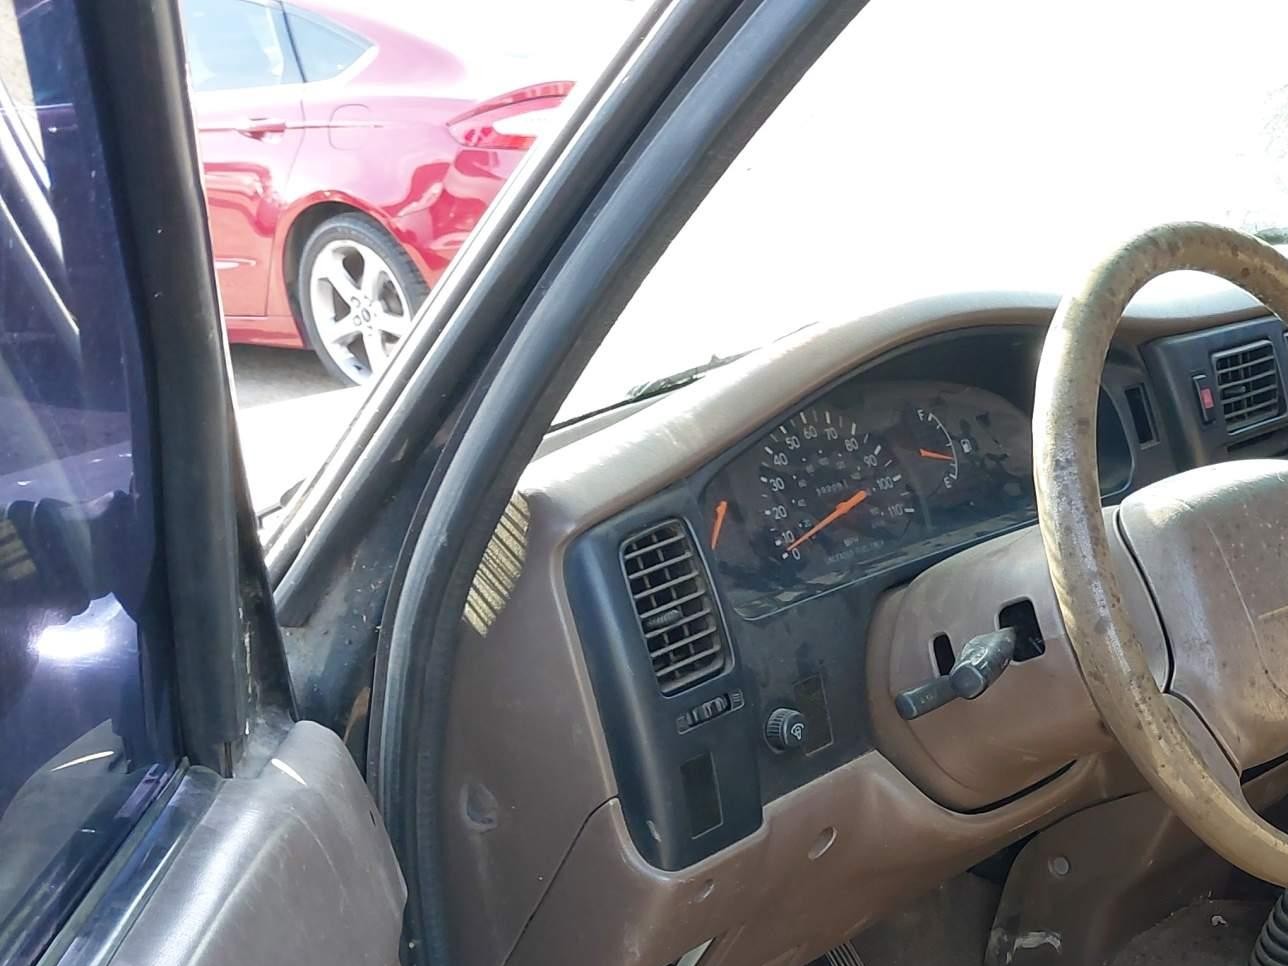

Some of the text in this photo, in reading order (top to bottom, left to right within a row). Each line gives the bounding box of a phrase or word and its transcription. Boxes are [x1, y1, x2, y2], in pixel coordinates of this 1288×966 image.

[917, 409, 924, 421] F
[803, 425, 818, 440] 60
[824, 427, 839, 441] 70
[785, 436, 801, 450] 50
[845, 438, 859, 452] 80
[773, 453, 788, 466] 40
[864, 454, 878, 468] 90
[769, 477, 785, 492] 30
[876, 476, 894, 490] 100
[944, 476, 952, 488] E
[772, 505, 788, 519] 20
[888, 503, 903, 517] 110
[782, 530, 795, 543] 10
[792, 548, 801, 560] 0
